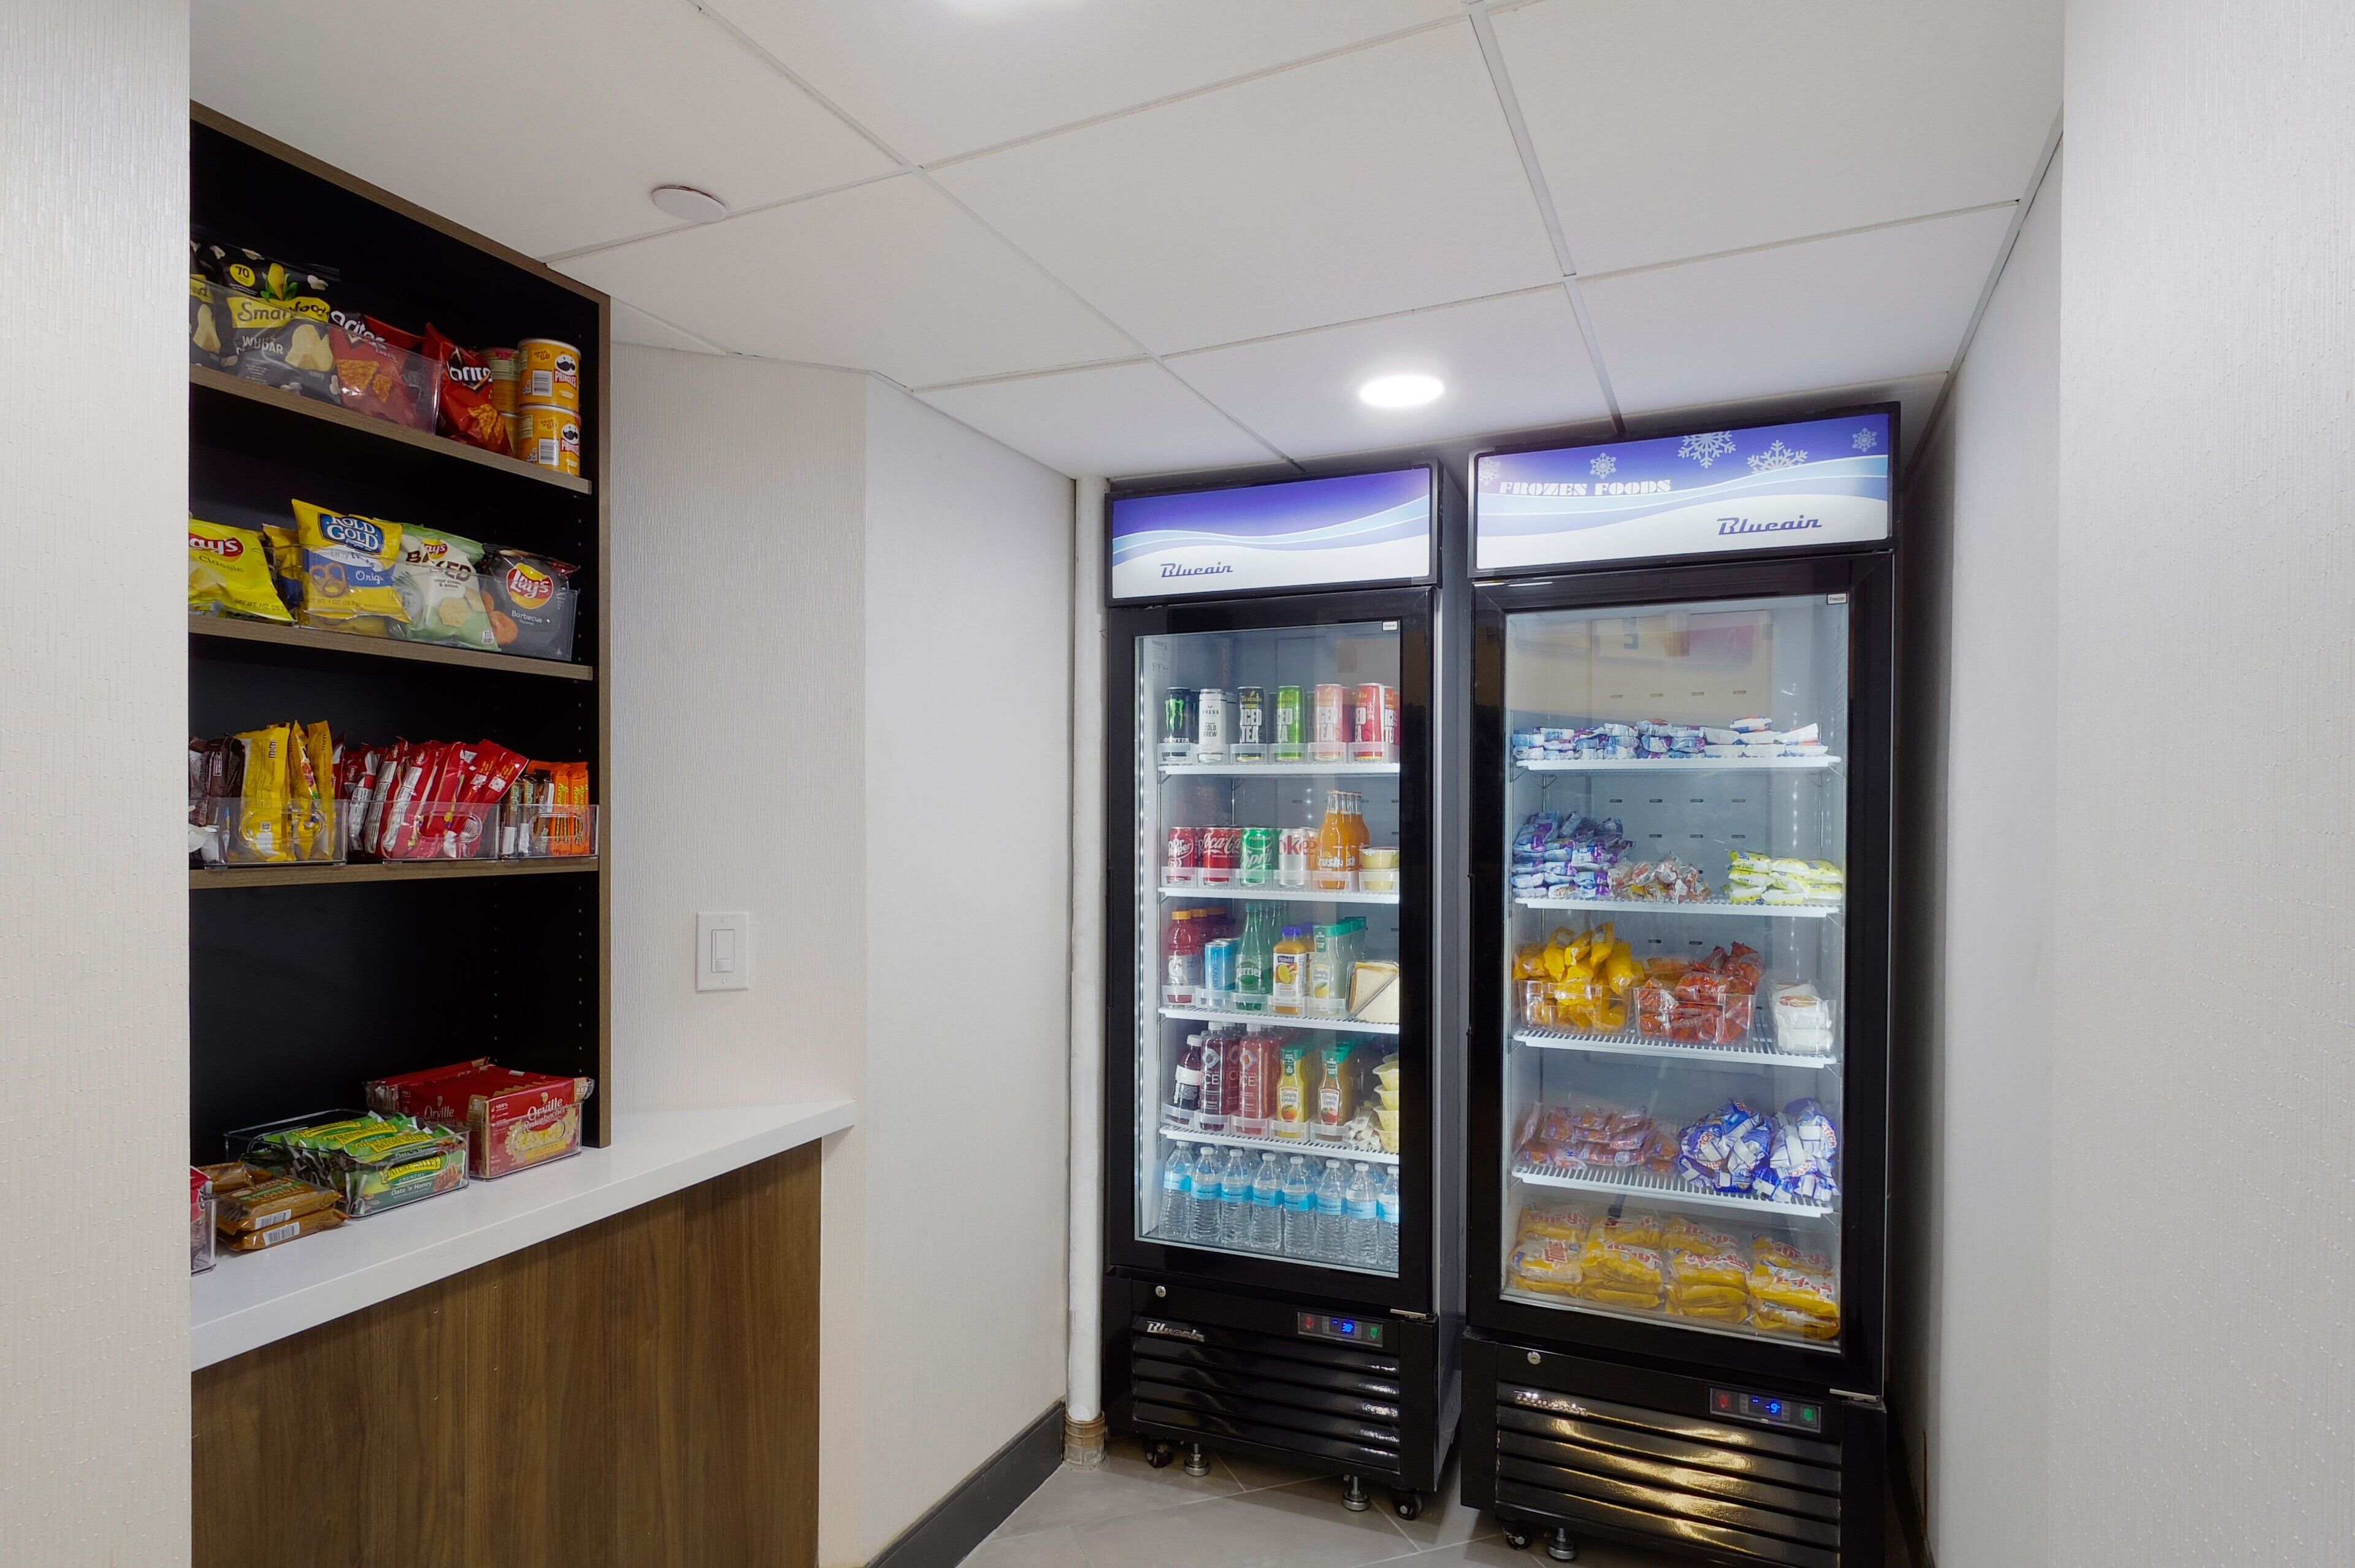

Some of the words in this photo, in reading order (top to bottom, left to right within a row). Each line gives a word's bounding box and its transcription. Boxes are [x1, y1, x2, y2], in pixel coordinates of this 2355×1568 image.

[236, 266, 249, 278] 70
[555, 371, 576, 388] PRINGLES
[1499, 480, 1588, 496] FROZEN
[1595, 479, 1671, 496] FOODS
[1717, 514, 1823, 535] Blueair
[327, 524, 378, 550] GOLD
[189, 537, 239, 555] ay's
[199, 555, 245, 573] Classic
[1160, 561, 1234, 578] Blueair
[510, 569, 550, 599] Lay's
[511, 610, 543, 623] Barbecue
[424, 1106, 454, 1120] Orville
[527, 1097, 563, 1121] Orville
[413, 1181, 432, 1191] Honey
